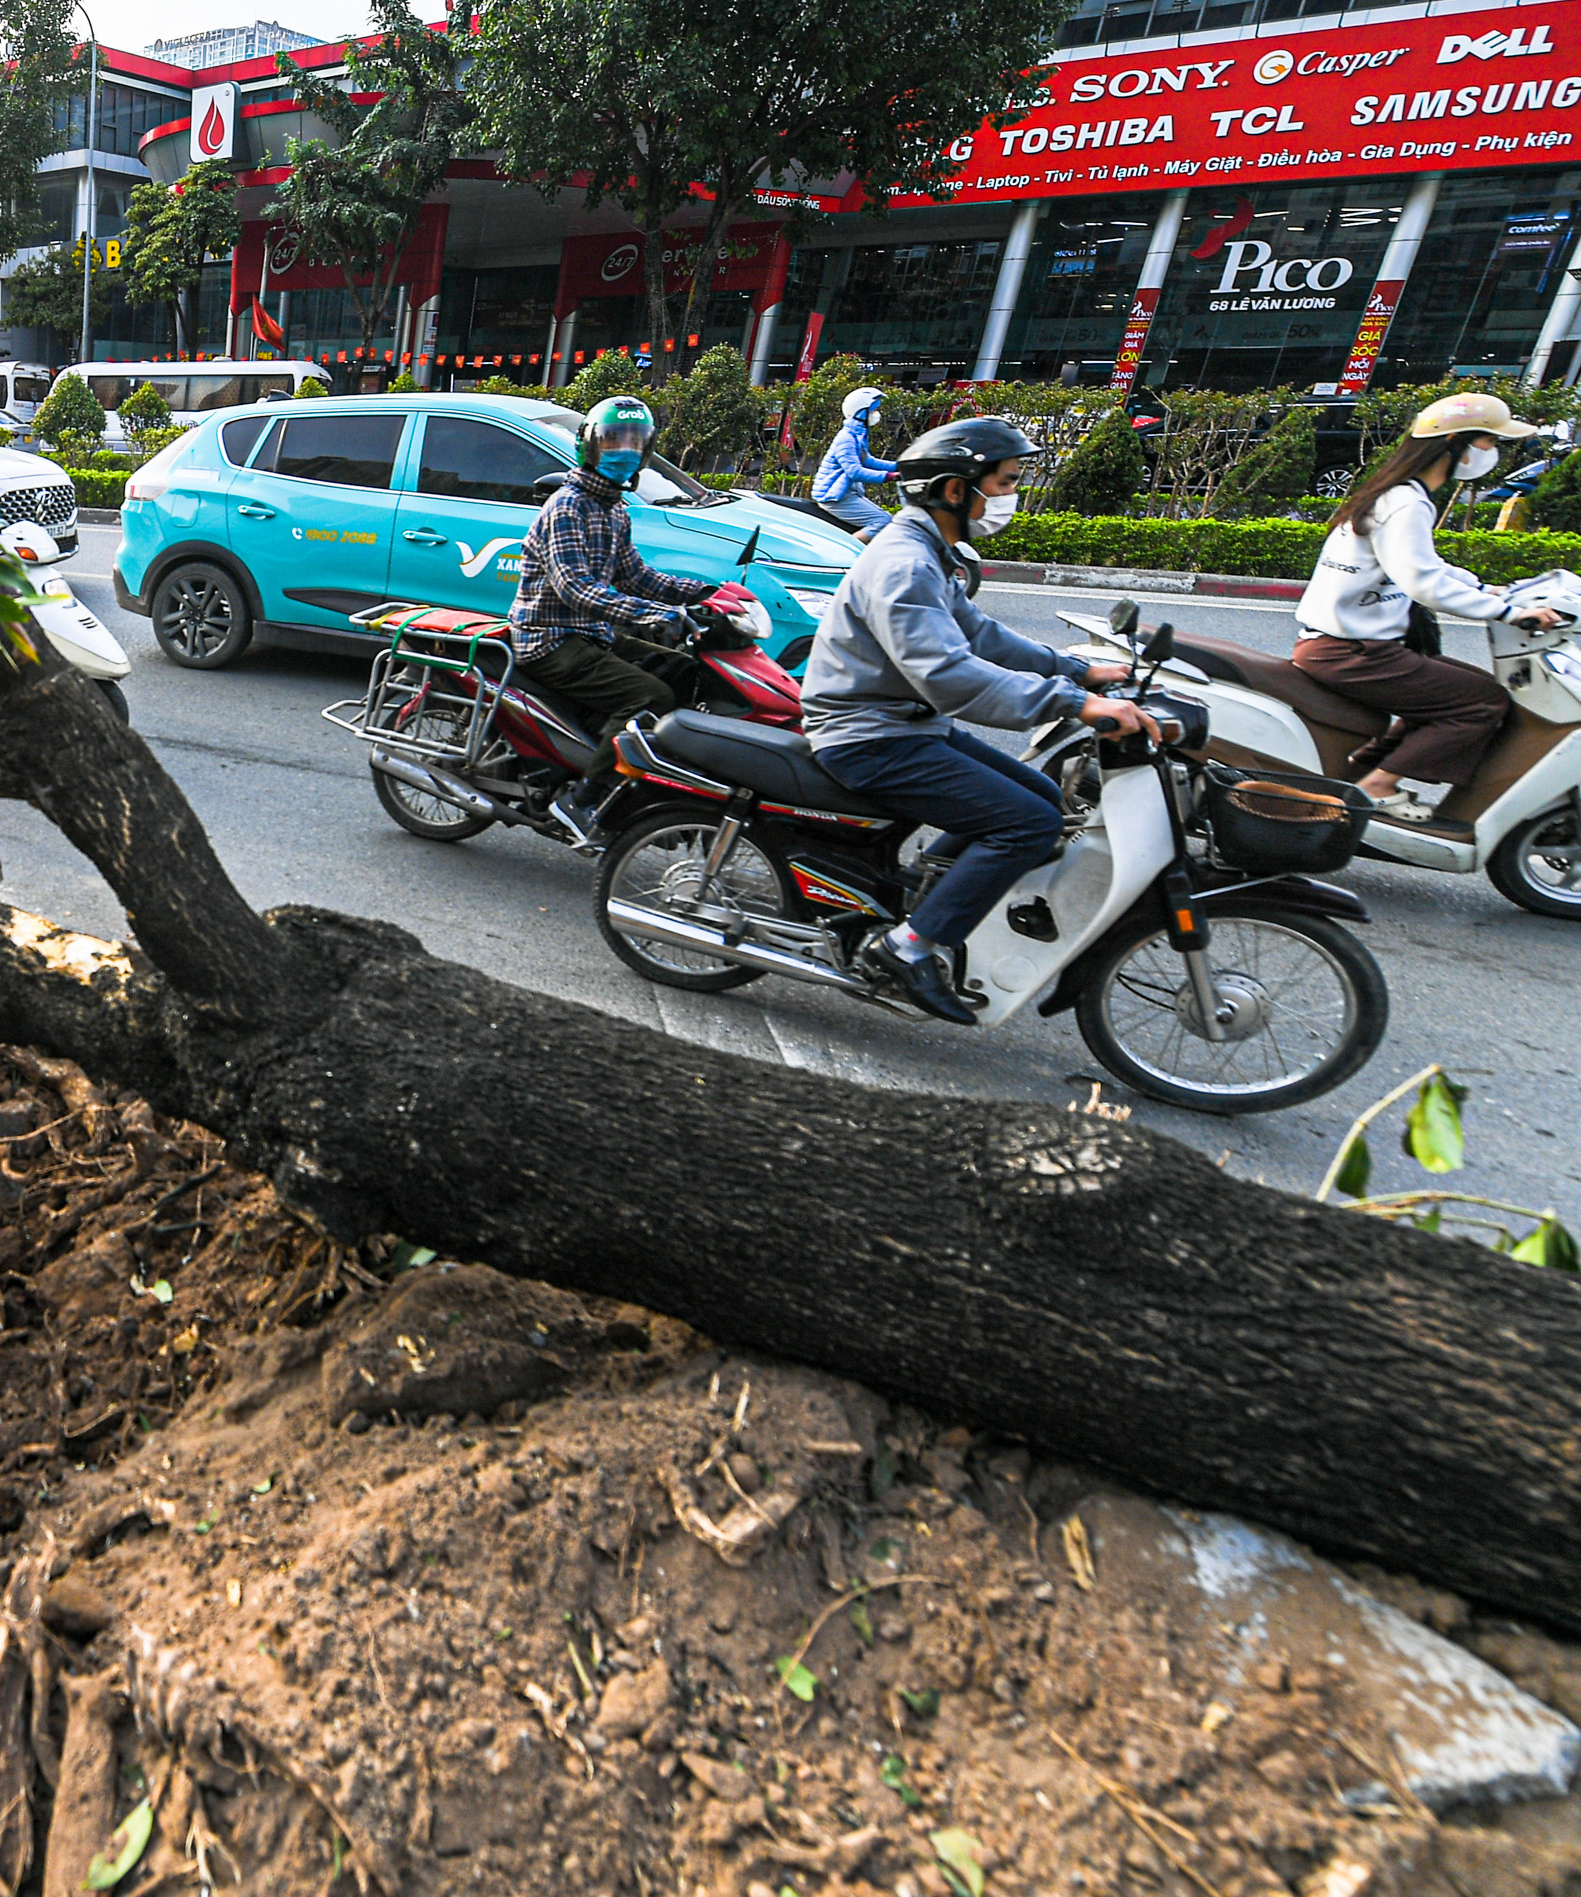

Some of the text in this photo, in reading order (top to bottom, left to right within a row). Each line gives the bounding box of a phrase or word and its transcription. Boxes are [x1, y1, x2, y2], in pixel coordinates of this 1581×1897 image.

[1069, 60, 1234, 103] SONY
[1297, 48, 1410, 76] Casper
[1436, 25, 1554, 64] DELL
[999, 115, 1174, 156] TOSHIBA
[1210, 105, 1304, 137] TCL
[1350, 76, 1581, 126] SAMSUNG
[976, 172, 1030, 190] Laptop
[1045, 169, 1074, 183] Tivi
[1087, 166, 1109, 181] Tủ
[1112, 164, 1149, 182] lạnh
[1164, 158, 1201, 176] Máy
[1205, 155, 1243, 173] Giặt
[1257, 148, 1299, 168] Điều
[1305, 149, 1342, 165] hòa
[1360, 143, 1395, 160] Gia
[1399, 140, 1456, 158] Dụng
[1474, 135, 1518, 153] Phụ
[1524, 131, 1572, 148] kiện
[608, 257, 635, 268] 24/7
[1209, 300, 1229, 311] 68
[1230, 296, 1251, 311] LÊ
[1251, 297, 1281, 310] VĂN
[1358, 328, 1382, 341] GIÁ
[1350, 342, 1379, 356] SỐC
[1341, 370, 1370, 381] NGÀY
[617, 410, 645, 420] Grab
[306, 528, 337, 543] 1900
[794, 809, 838, 821] HONDA
